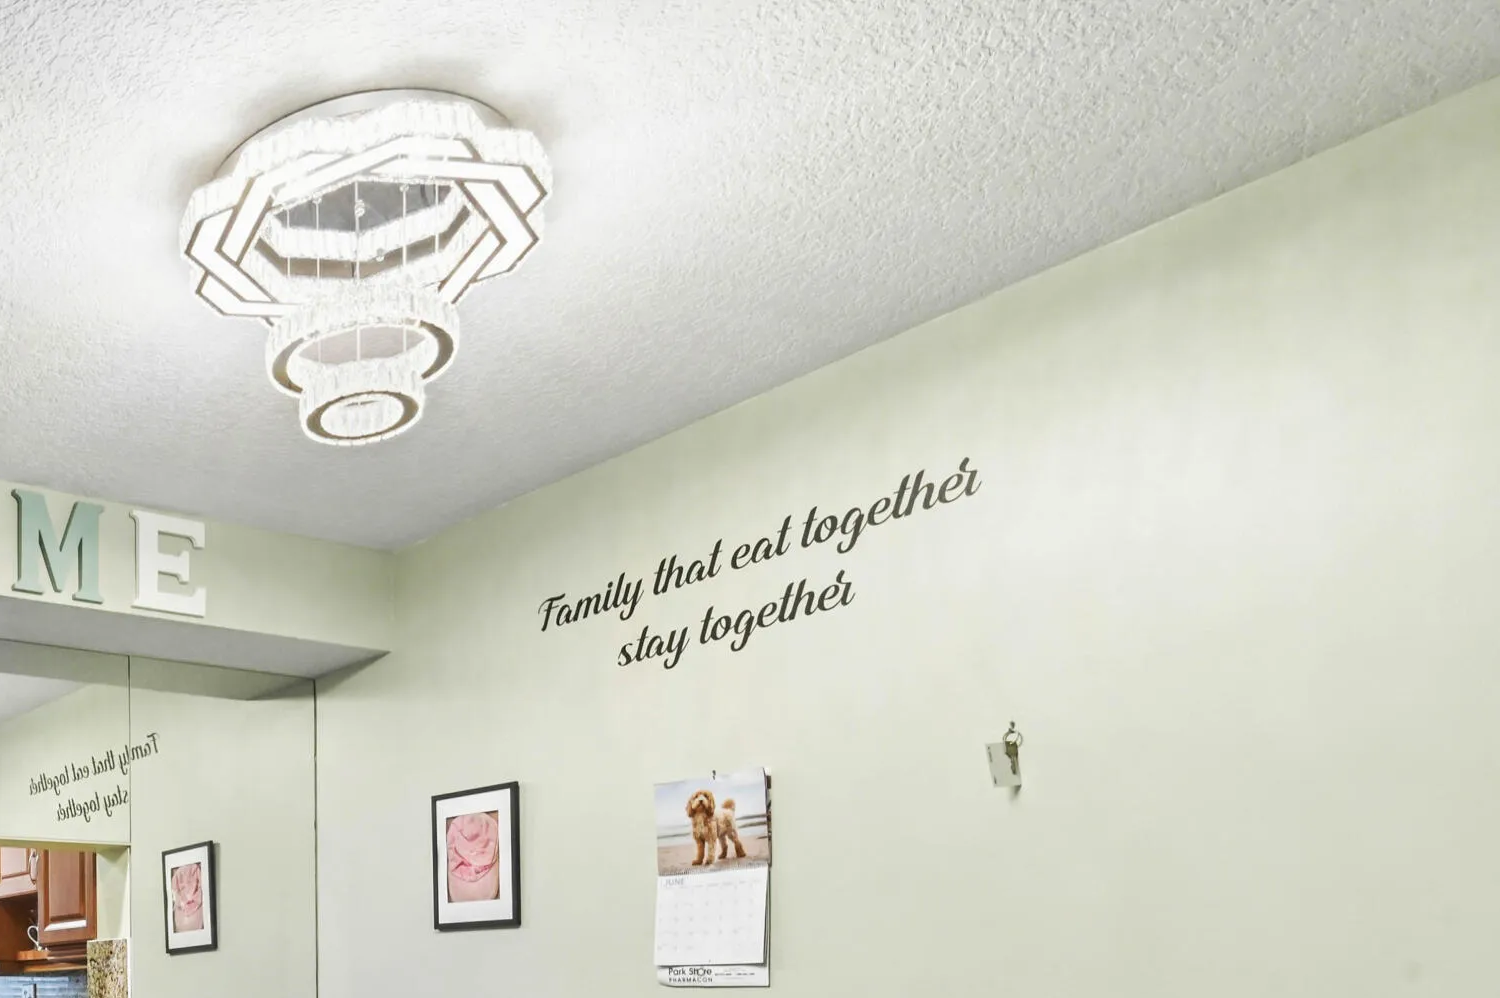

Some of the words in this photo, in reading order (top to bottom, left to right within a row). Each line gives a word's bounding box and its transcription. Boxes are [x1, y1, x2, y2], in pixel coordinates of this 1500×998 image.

[537, 571, 644, 633] Family
[652, 537, 723, 597] that
[730, 514, 792, 571] eat
[800, 456, 983, 555] together
[617, 624, 690, 670] stay
[699, 568, 856, 653] together
[668, 967, 687, 976] Park
